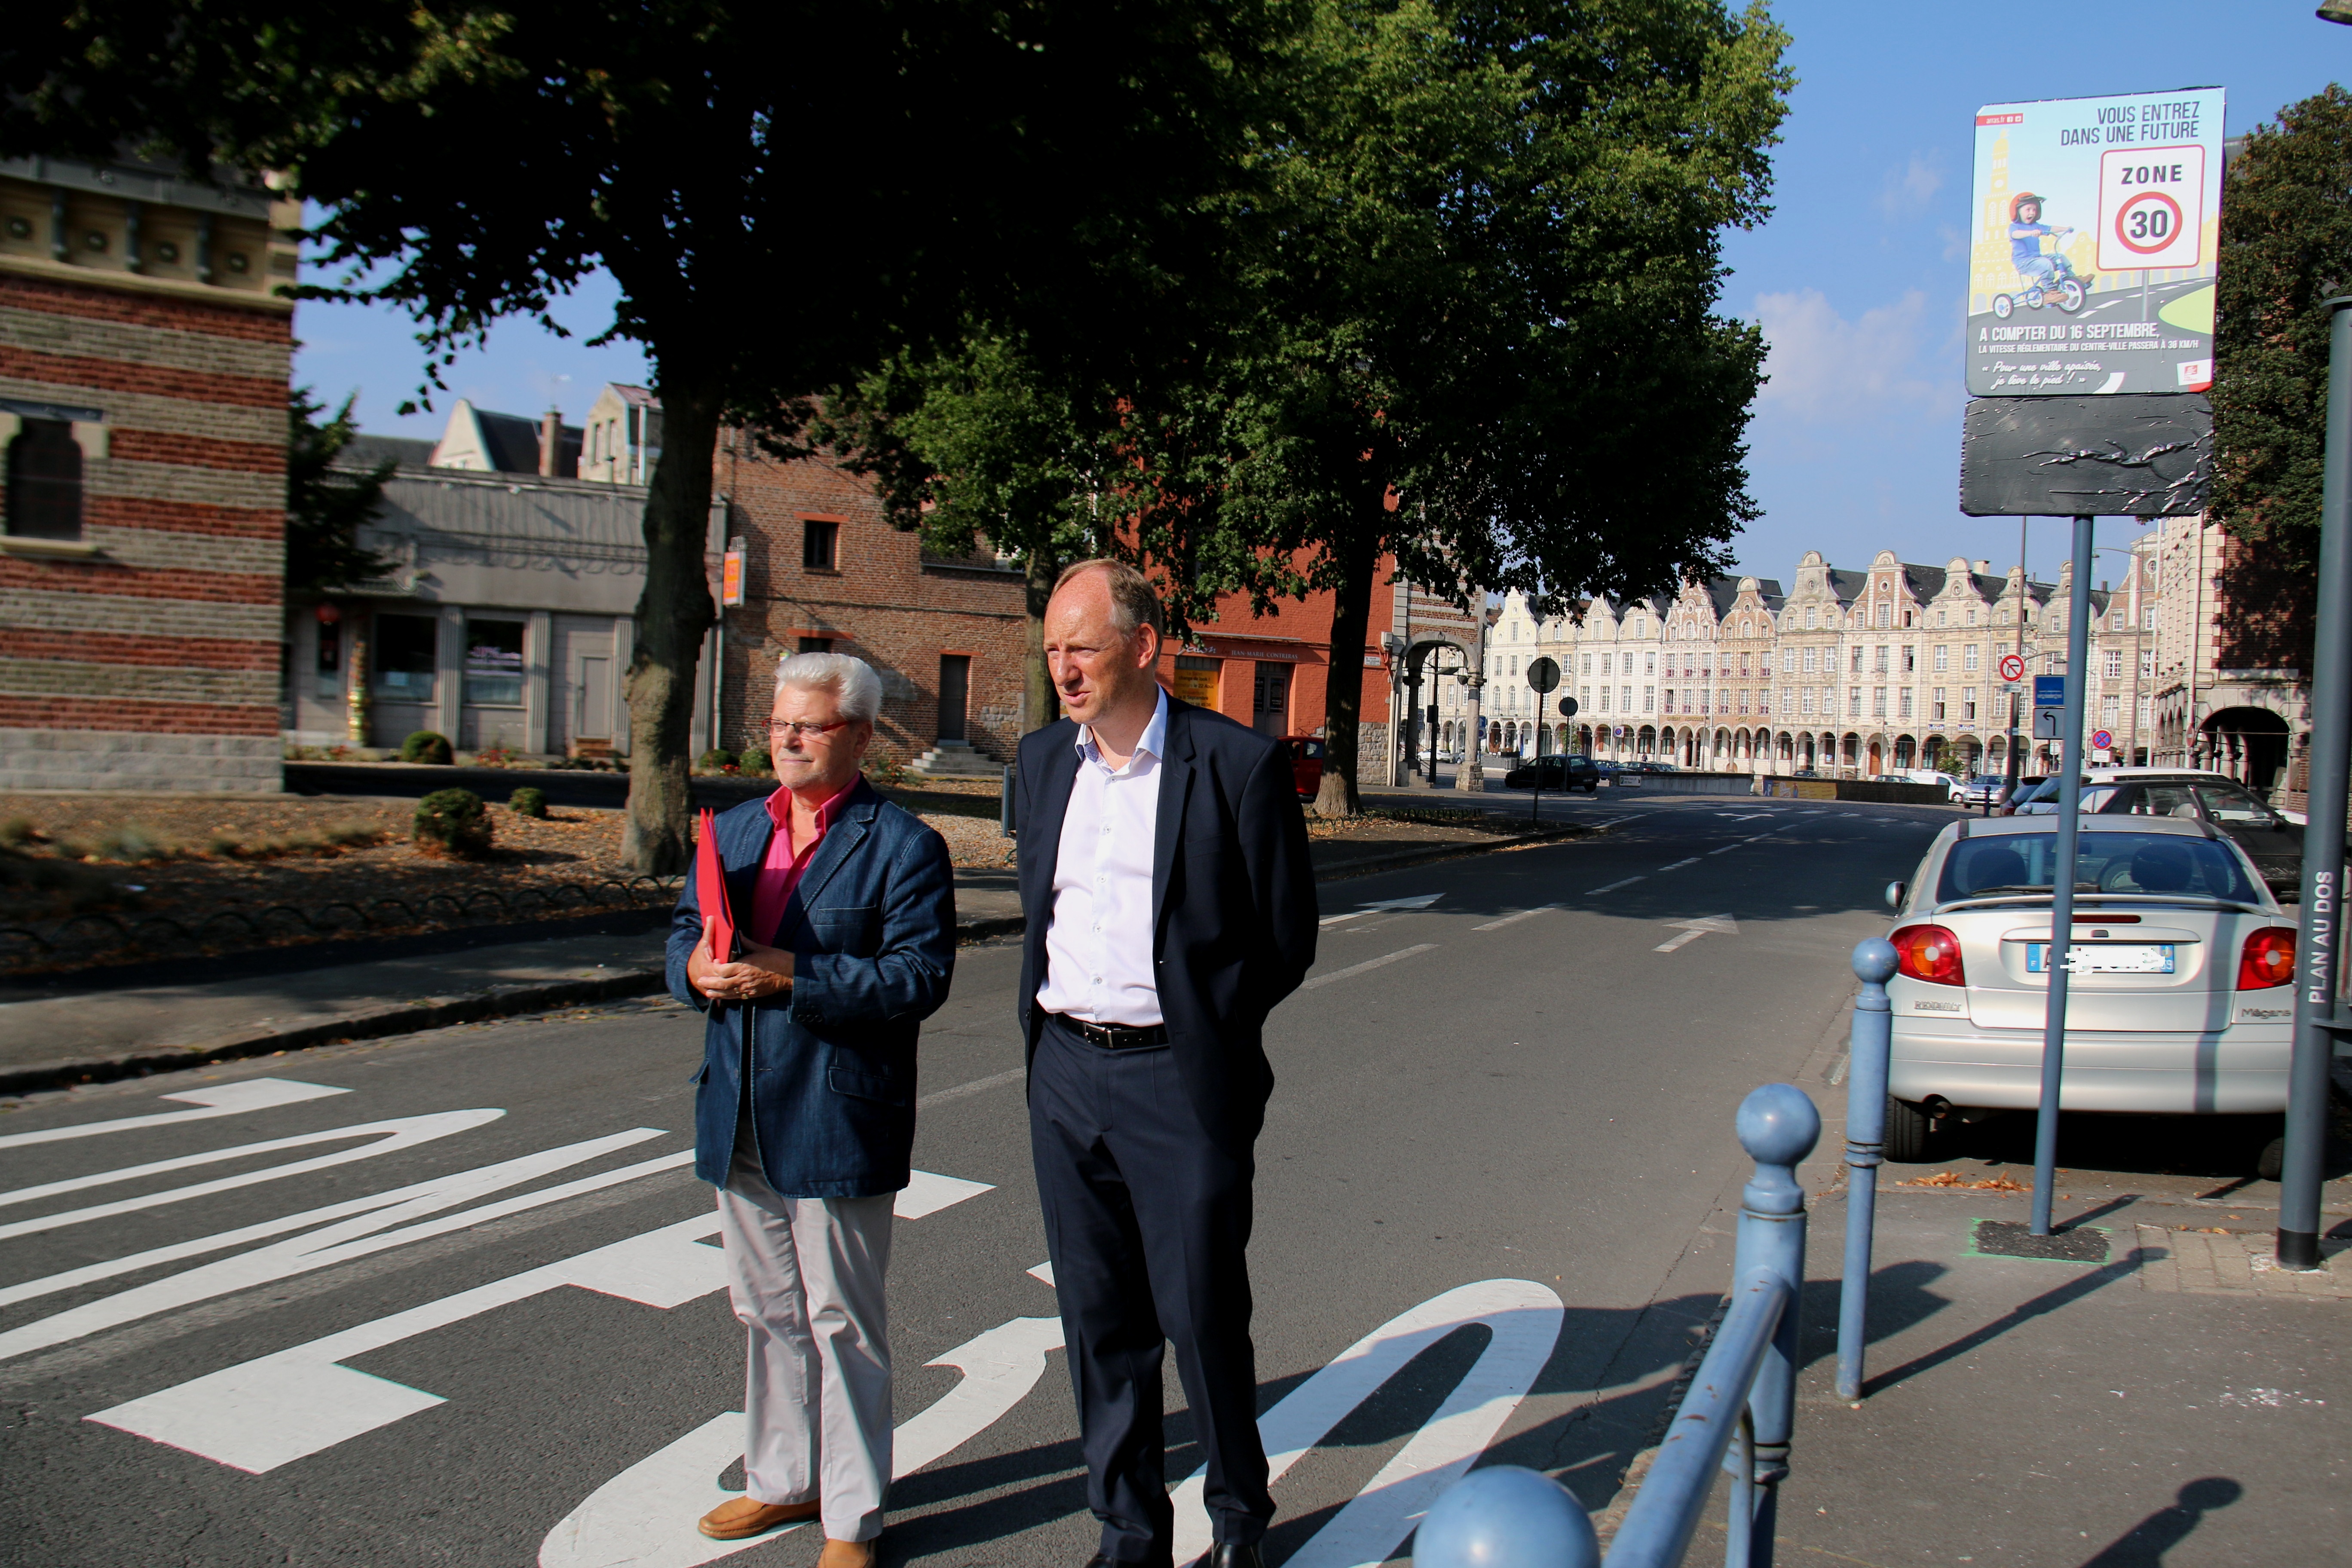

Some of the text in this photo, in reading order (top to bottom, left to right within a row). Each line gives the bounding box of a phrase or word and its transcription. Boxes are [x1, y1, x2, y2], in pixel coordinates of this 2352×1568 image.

[2098, 101, 2200, 124] VOUS ENTREZ
[2061, 120, 2199, 146] DANS UNE FUTURE
[2121, 164, 2182, 185] ZONE
[2130, 209, 2168, 239] 30
[1979, 323, 2160, 341] A COMPTER DU 16 SEPTEMBRE,
[1978, 340, 2199, 353] LA VITESSE RÉGLEMENTAIRE DU CENTRE-VILLE PASSERA À 30 KM/H
[1993, 361, 2017, 373] Pour
[2040, 360, 2062, 371] ville
[2064, 360, 2102, 375] apaisée,
[1991, 375, 2006, 390] je
[2007, 374, 2027, 385] lève
[2030, 374, 2041, 384] le
[2040, 374, 2064, 389] pied
[2308, 870, 2334, 1004] PLAN AU DOS
[1914, 1000, 1961, 1011] RENAULT
[2241, 1008, 2291, 1019] Mégane
